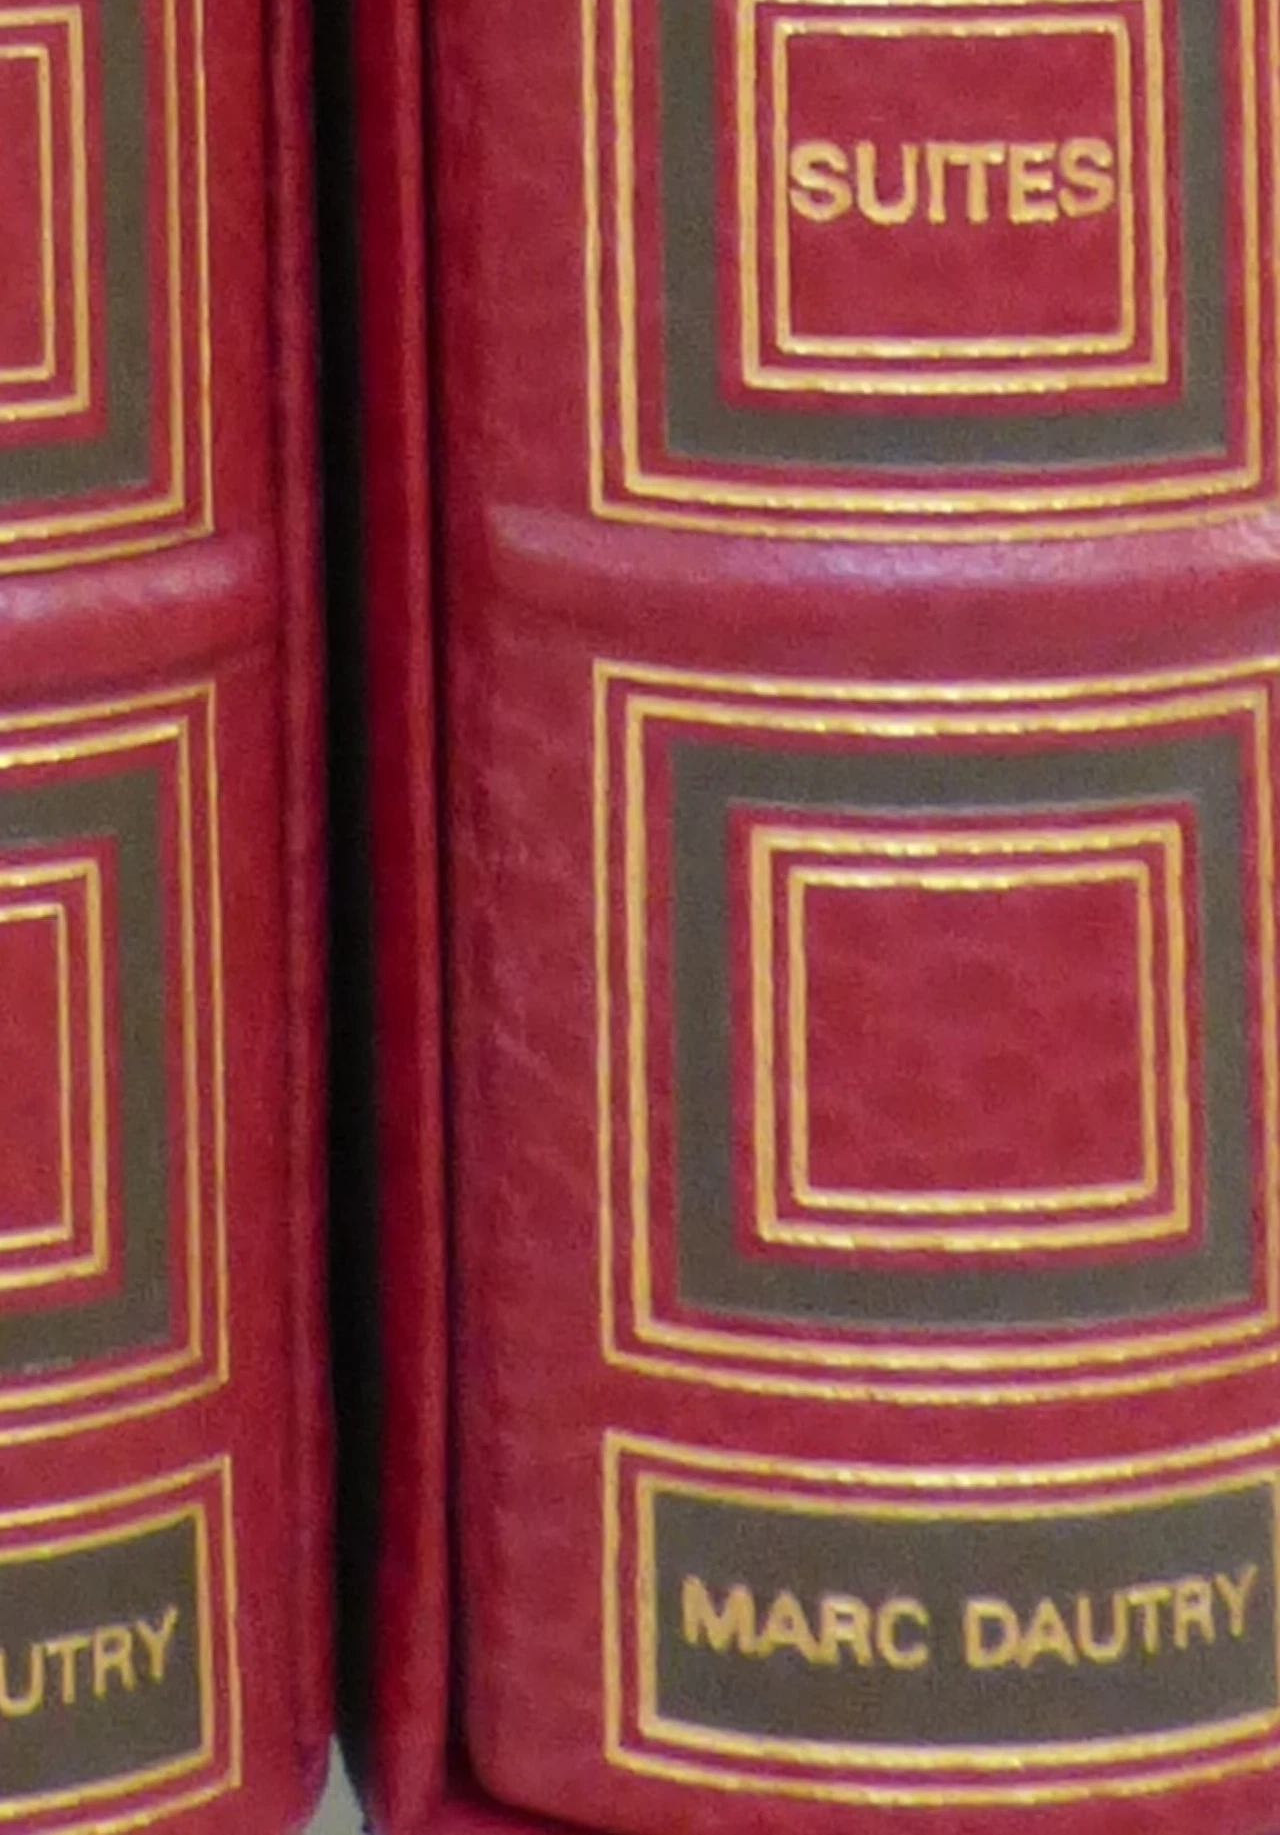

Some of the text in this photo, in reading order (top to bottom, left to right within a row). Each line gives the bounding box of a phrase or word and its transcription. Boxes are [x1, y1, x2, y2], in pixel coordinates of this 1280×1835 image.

[788, 136, 1116, 226] SUITES
[681, 1562, 1259, 1671] MARC DAUTRY
